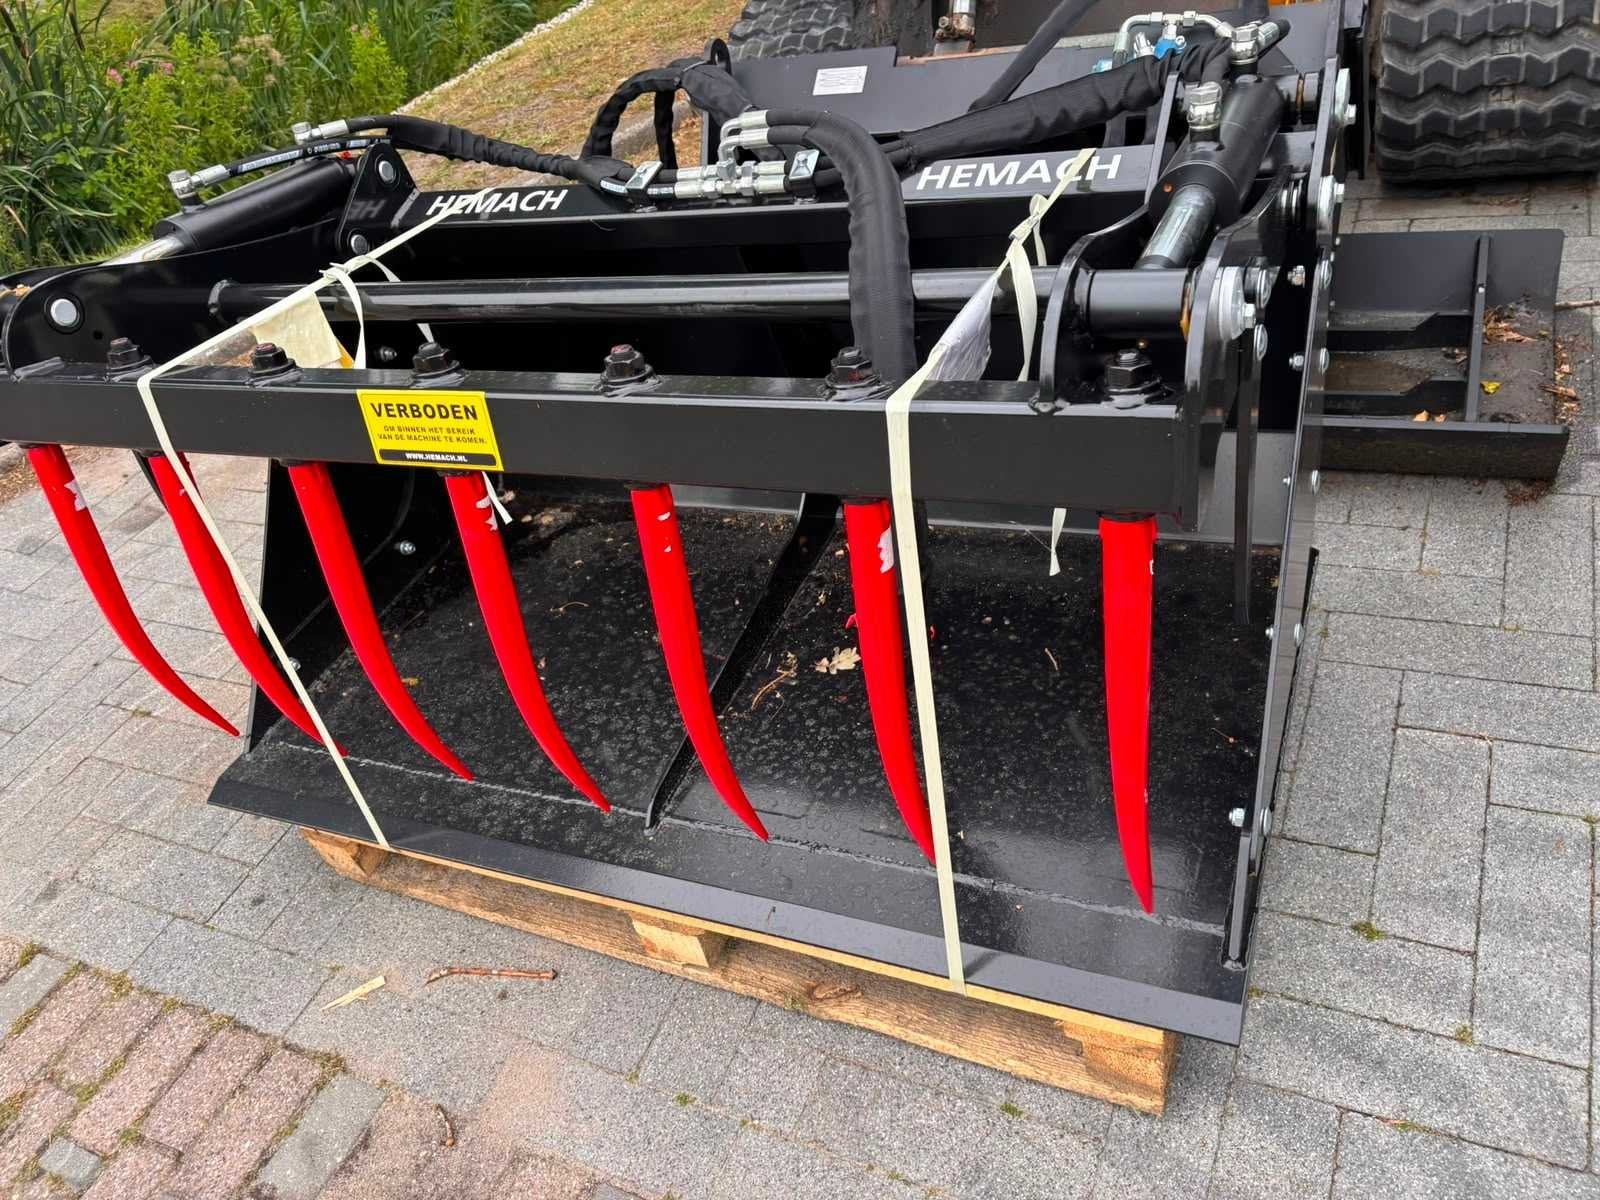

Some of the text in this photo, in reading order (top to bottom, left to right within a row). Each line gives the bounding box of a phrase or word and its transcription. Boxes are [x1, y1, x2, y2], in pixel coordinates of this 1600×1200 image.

[370, 402, 479, 421] VERBODEN
[398, 425, 427, 433] BINNEN
[429, 426, 443, 434] HET
[446, 427, 476, 435] BEREIK
[407, 434, 442, 442] MACHINE
[444, 435, 454, 443] TE
[456, 436, 487, 444] KOMEN.
[405, 452, 468, 463] WWW.HEMACH.NL
